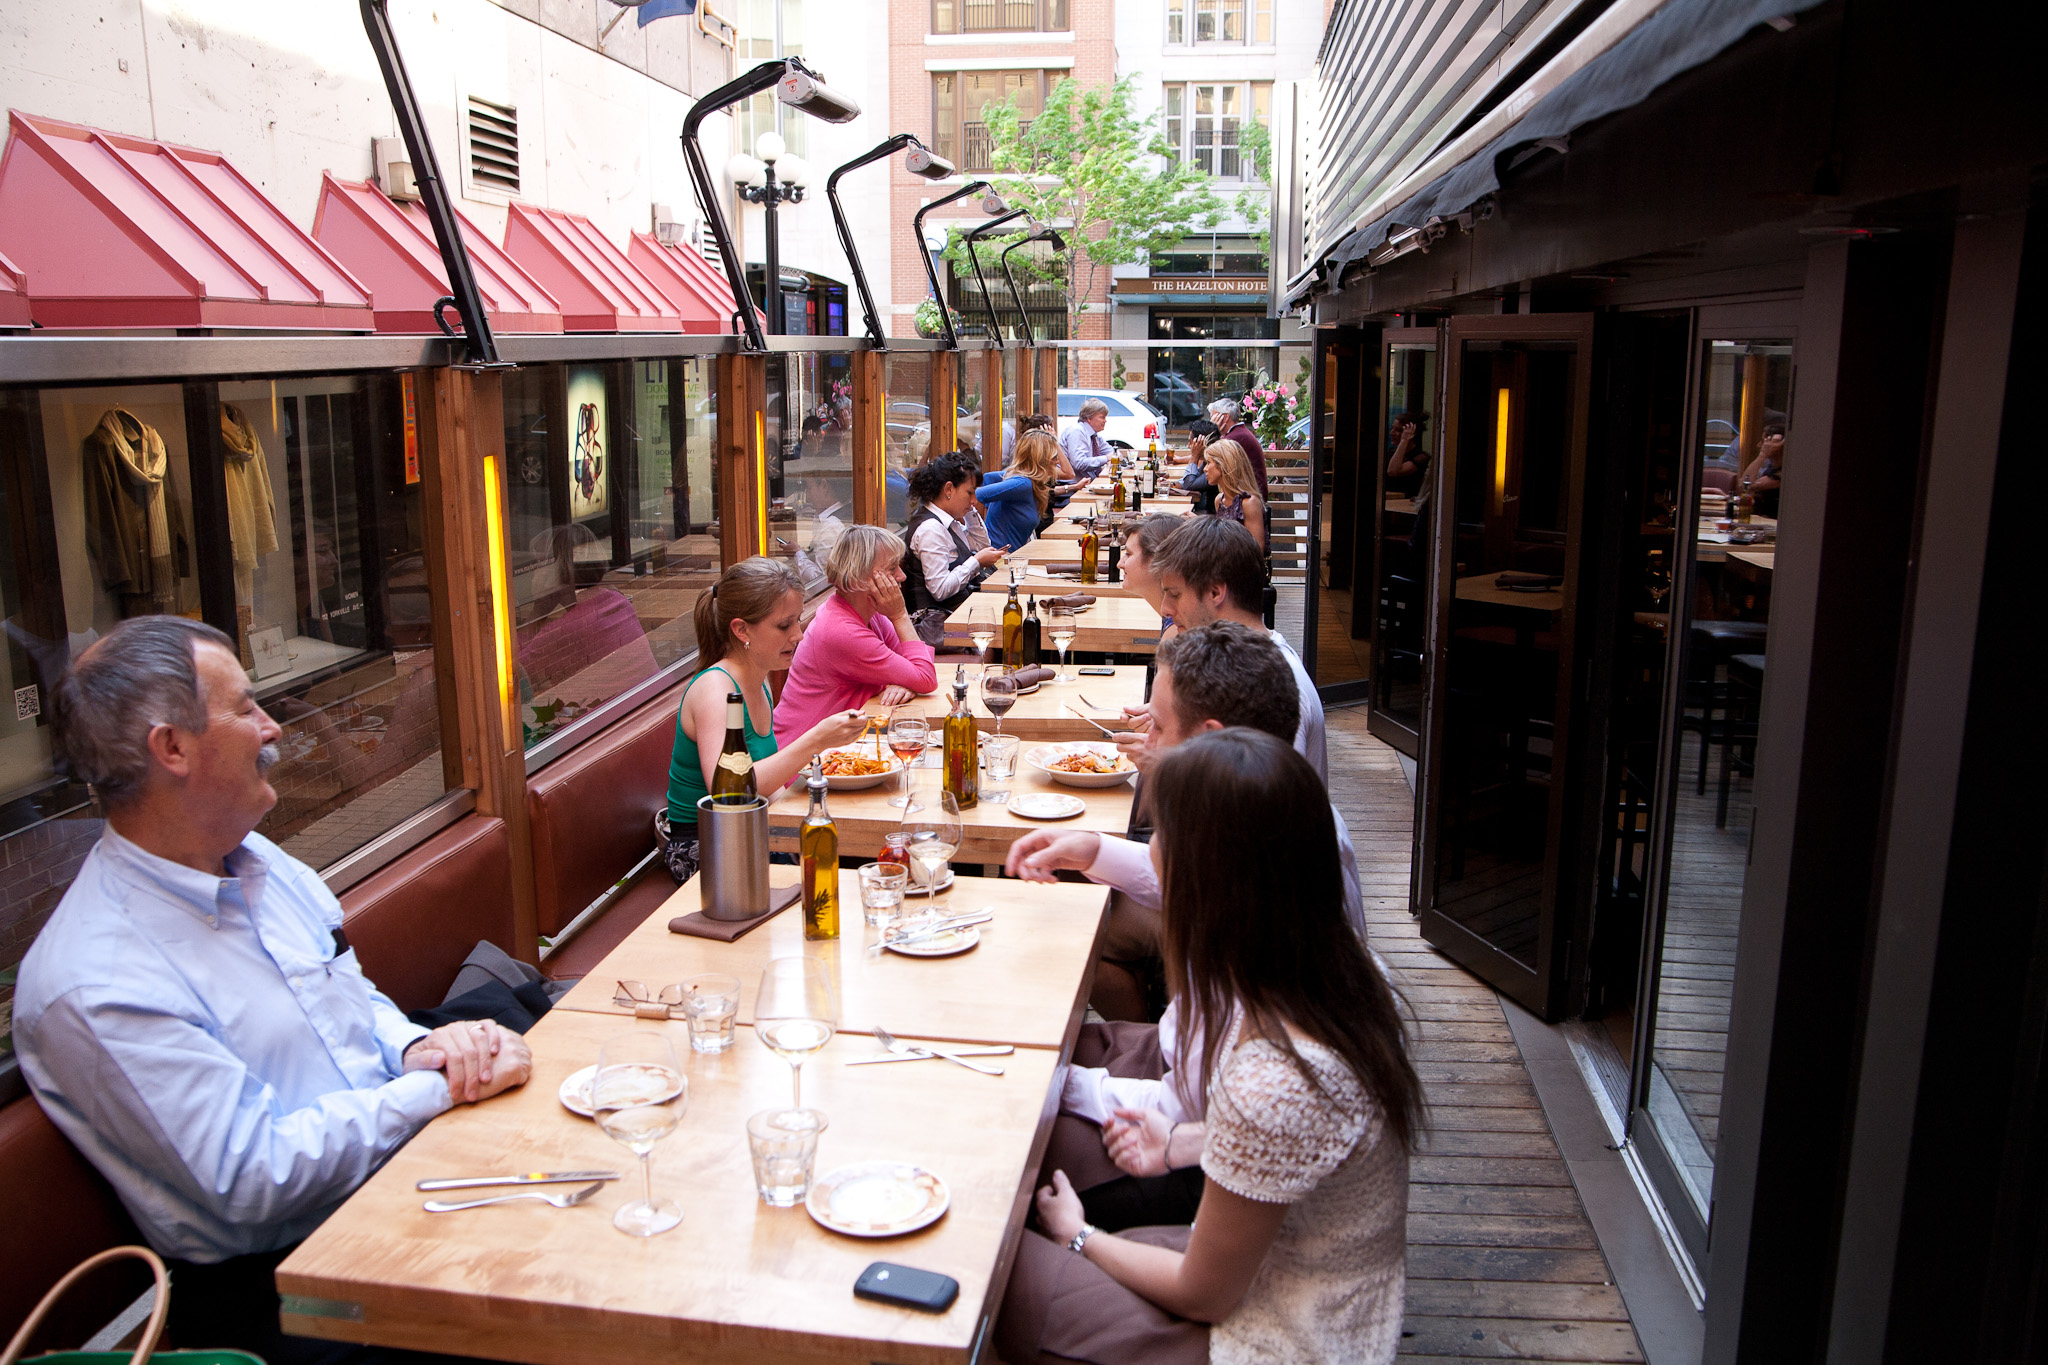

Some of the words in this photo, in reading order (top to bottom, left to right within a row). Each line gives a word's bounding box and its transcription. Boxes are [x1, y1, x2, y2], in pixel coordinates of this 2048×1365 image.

[1152, 281, 1174, 291] THE
[1175, 281, 1235, 291] HAZELTON
[1236, 281, 1268, 291] HOTE
[330, 606, 350, 618] YORKVILLE
